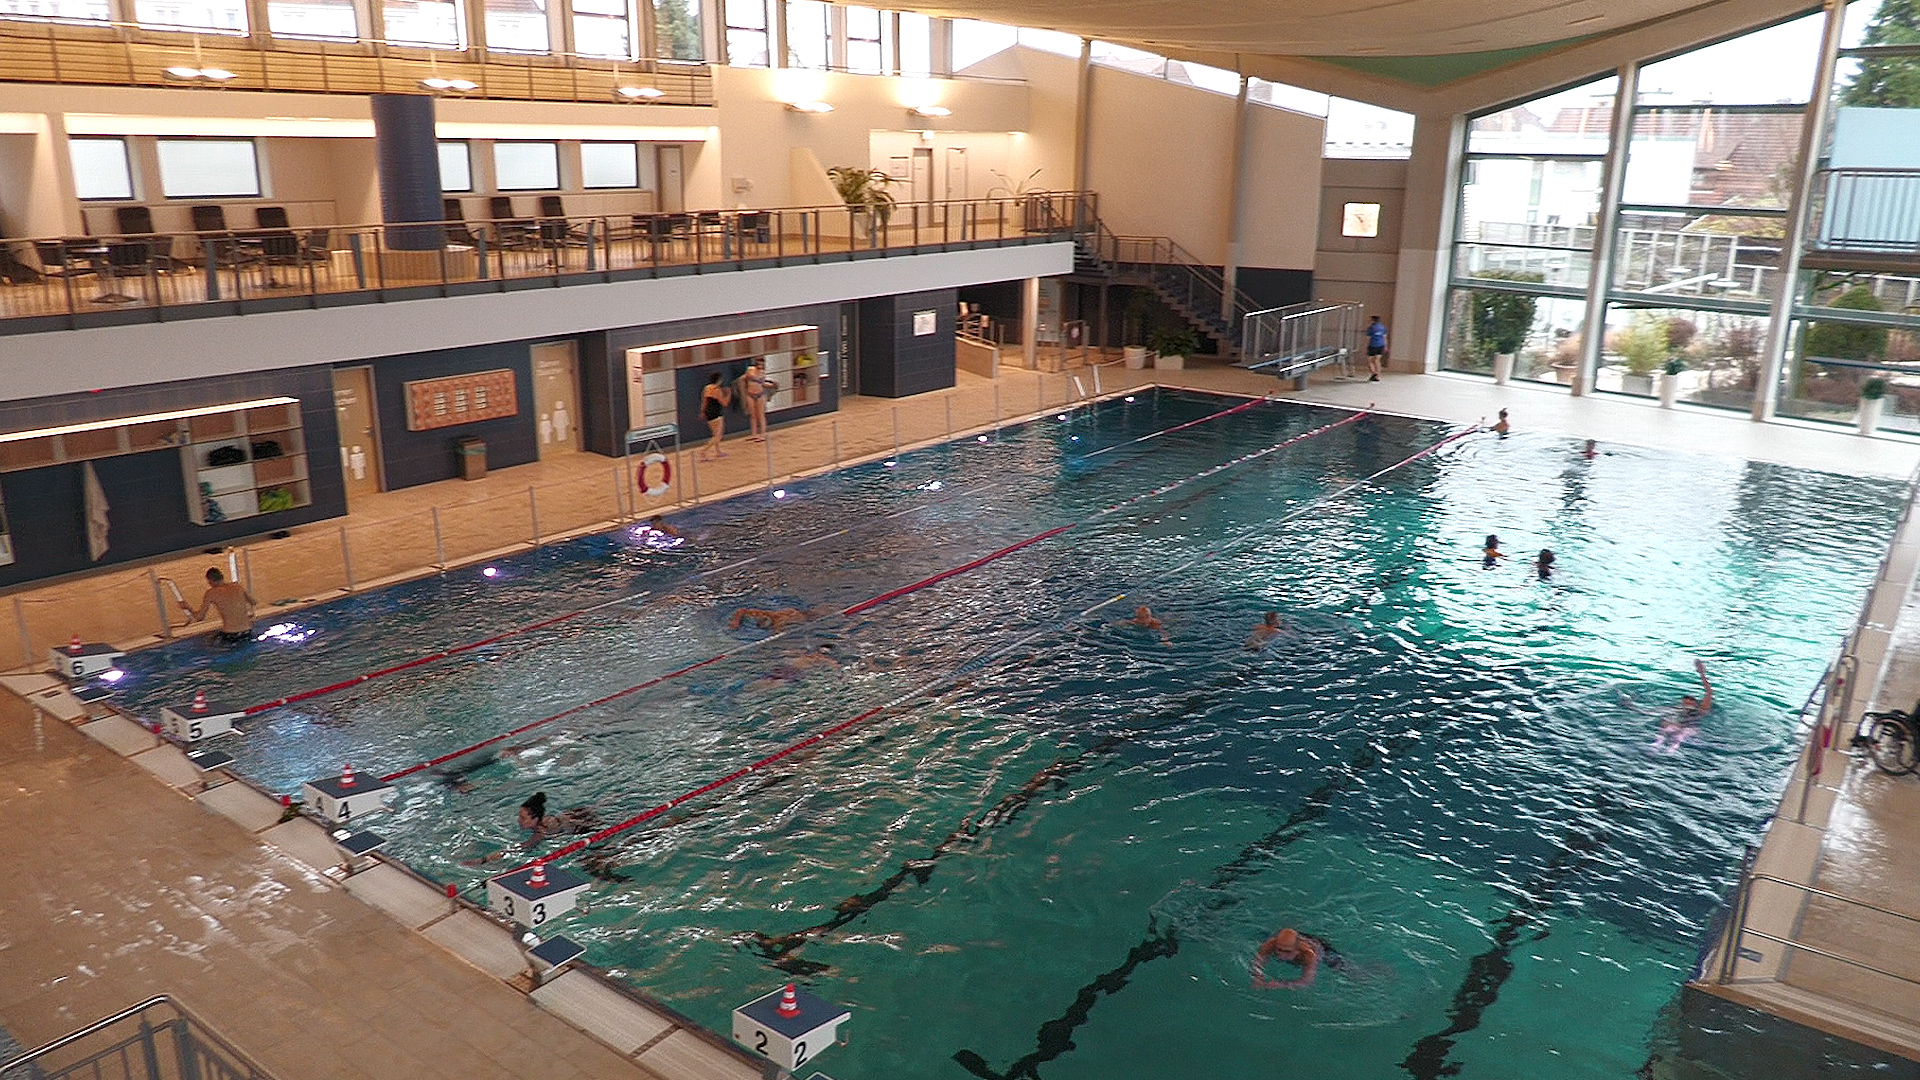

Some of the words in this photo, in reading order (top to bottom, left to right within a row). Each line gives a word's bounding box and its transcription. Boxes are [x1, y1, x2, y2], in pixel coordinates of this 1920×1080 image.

[72, 661, 84, 675] 6
[190, 722, 202, 738] 5
[338, 801, 351, 819] 4
[503, 895, 515, 917] 3
[533, 903, 546, 925] 3
[755, 1030, 769, 1056] 2
[794, 1041, 808, 1068] 2
